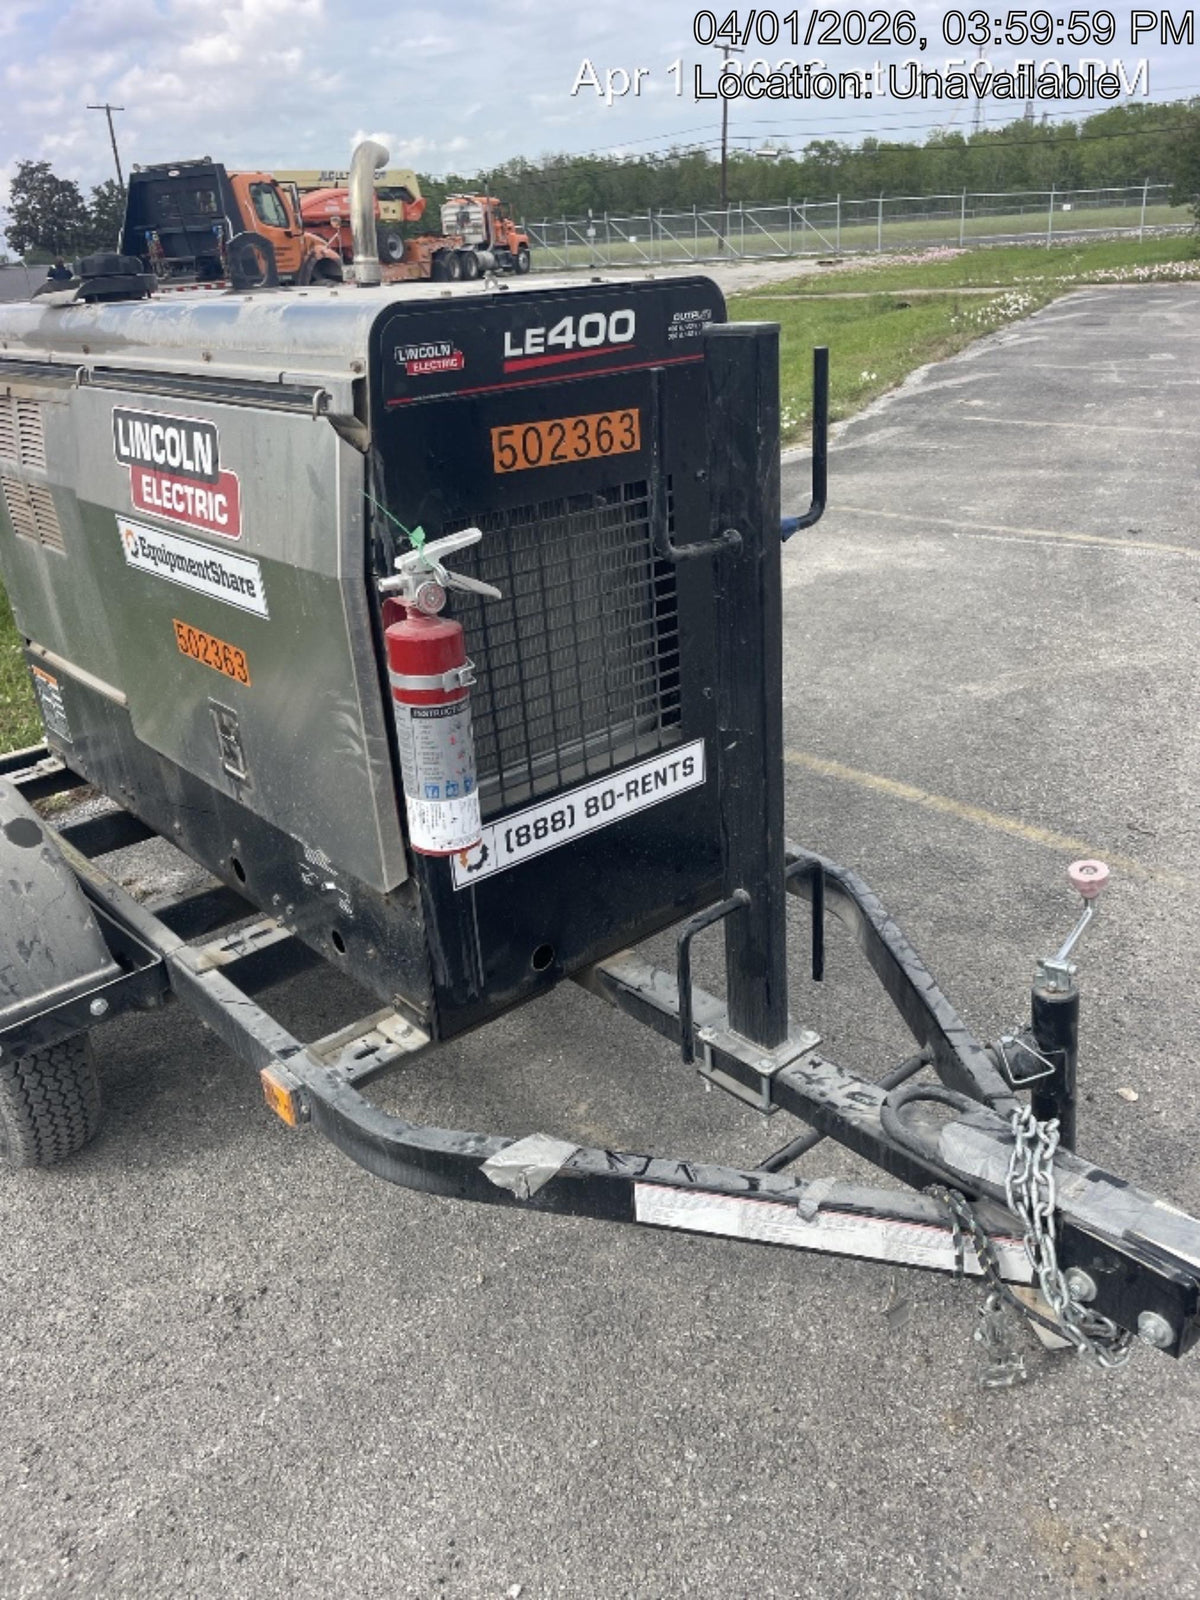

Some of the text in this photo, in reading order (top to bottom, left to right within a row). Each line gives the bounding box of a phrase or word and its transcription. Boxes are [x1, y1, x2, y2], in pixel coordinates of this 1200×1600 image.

[397, 344, 451, 362] LINCOLN
[504, 308, 636, 357] LE400
[413, 358, 458, 372] ELECTRIC
[116, 416, 213, 476] LINCOLN
[496, 411, 636, 471] 502363
[141, 474, 229, 526] ELECTRIC
[138, 535, 257, 599] EquipmentShare
[176, 625, 249, 684] 502363
[504, 804, 576, 854] (888)
[584, 756, 695, 818] 80-RENTS
